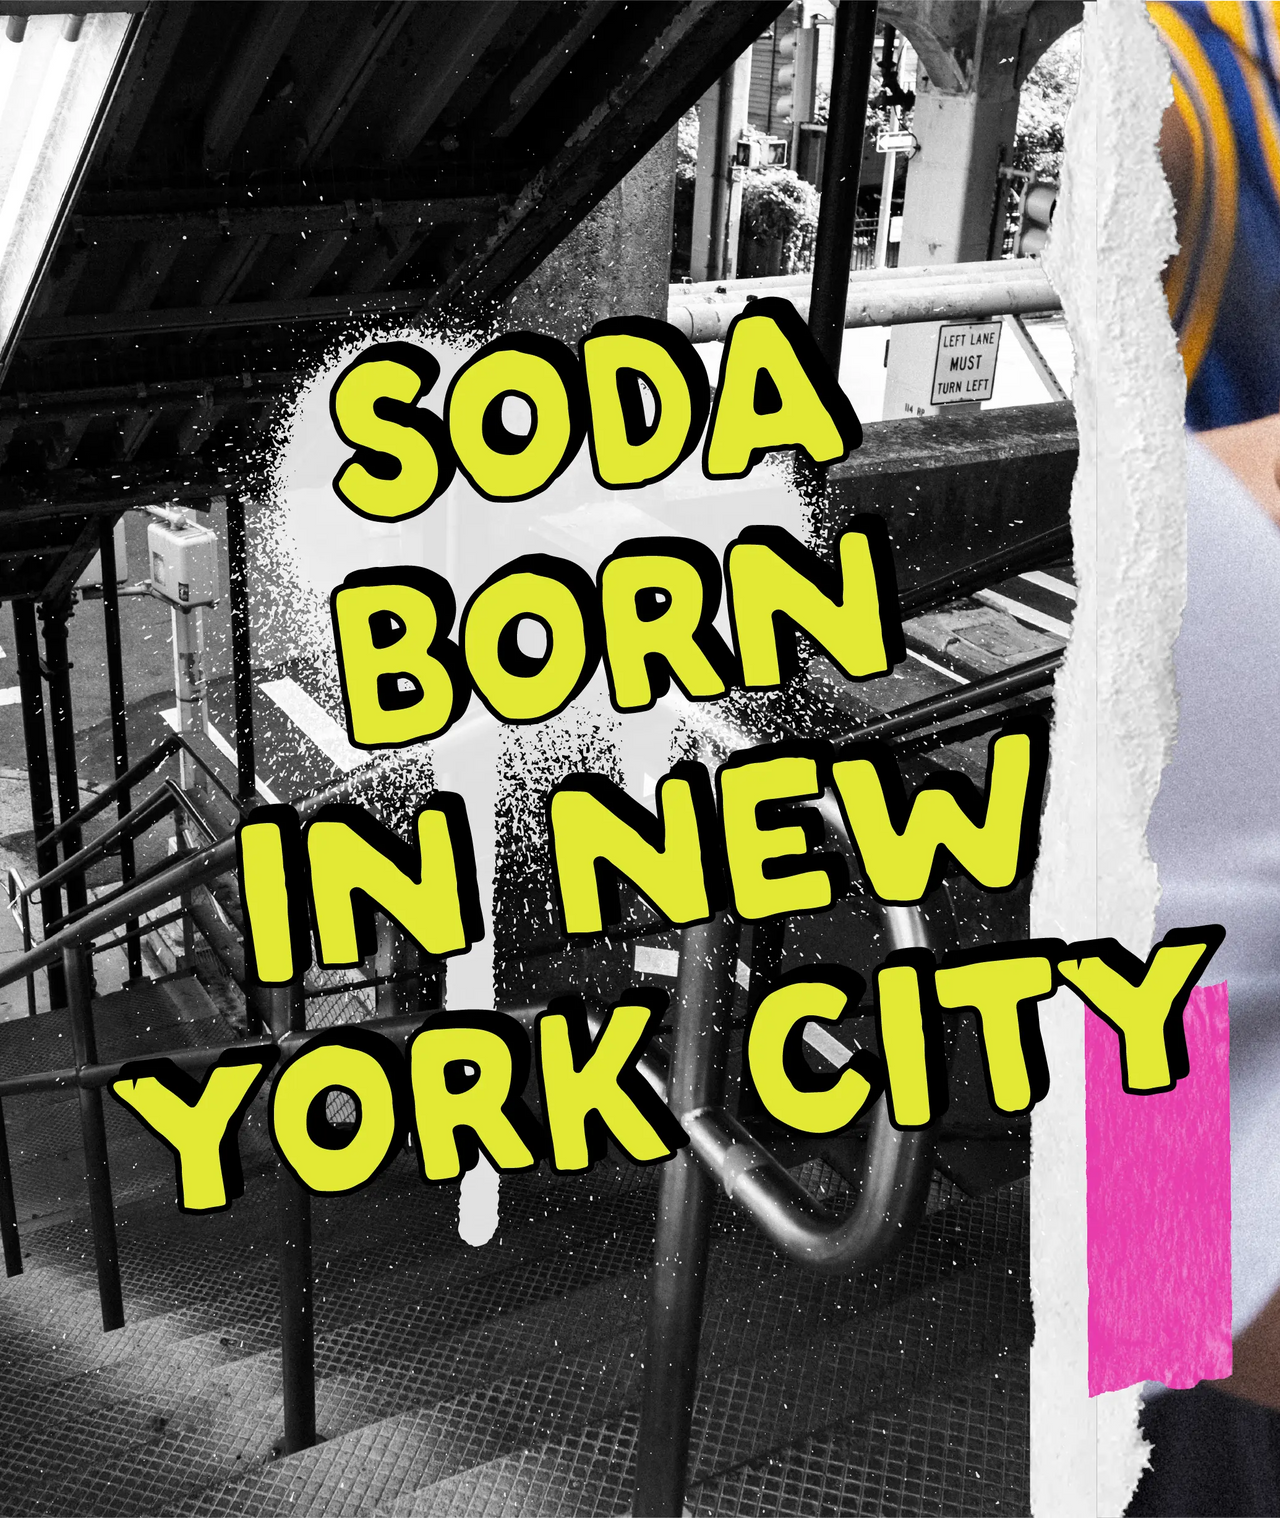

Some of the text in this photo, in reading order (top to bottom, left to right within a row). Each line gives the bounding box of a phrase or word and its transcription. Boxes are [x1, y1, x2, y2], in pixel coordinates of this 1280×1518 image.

[943, 332, 995, 348] LEFT LANE
[949, 355, 982, 372] MUST
[938, 379, 989, 395] TURN LEFT
